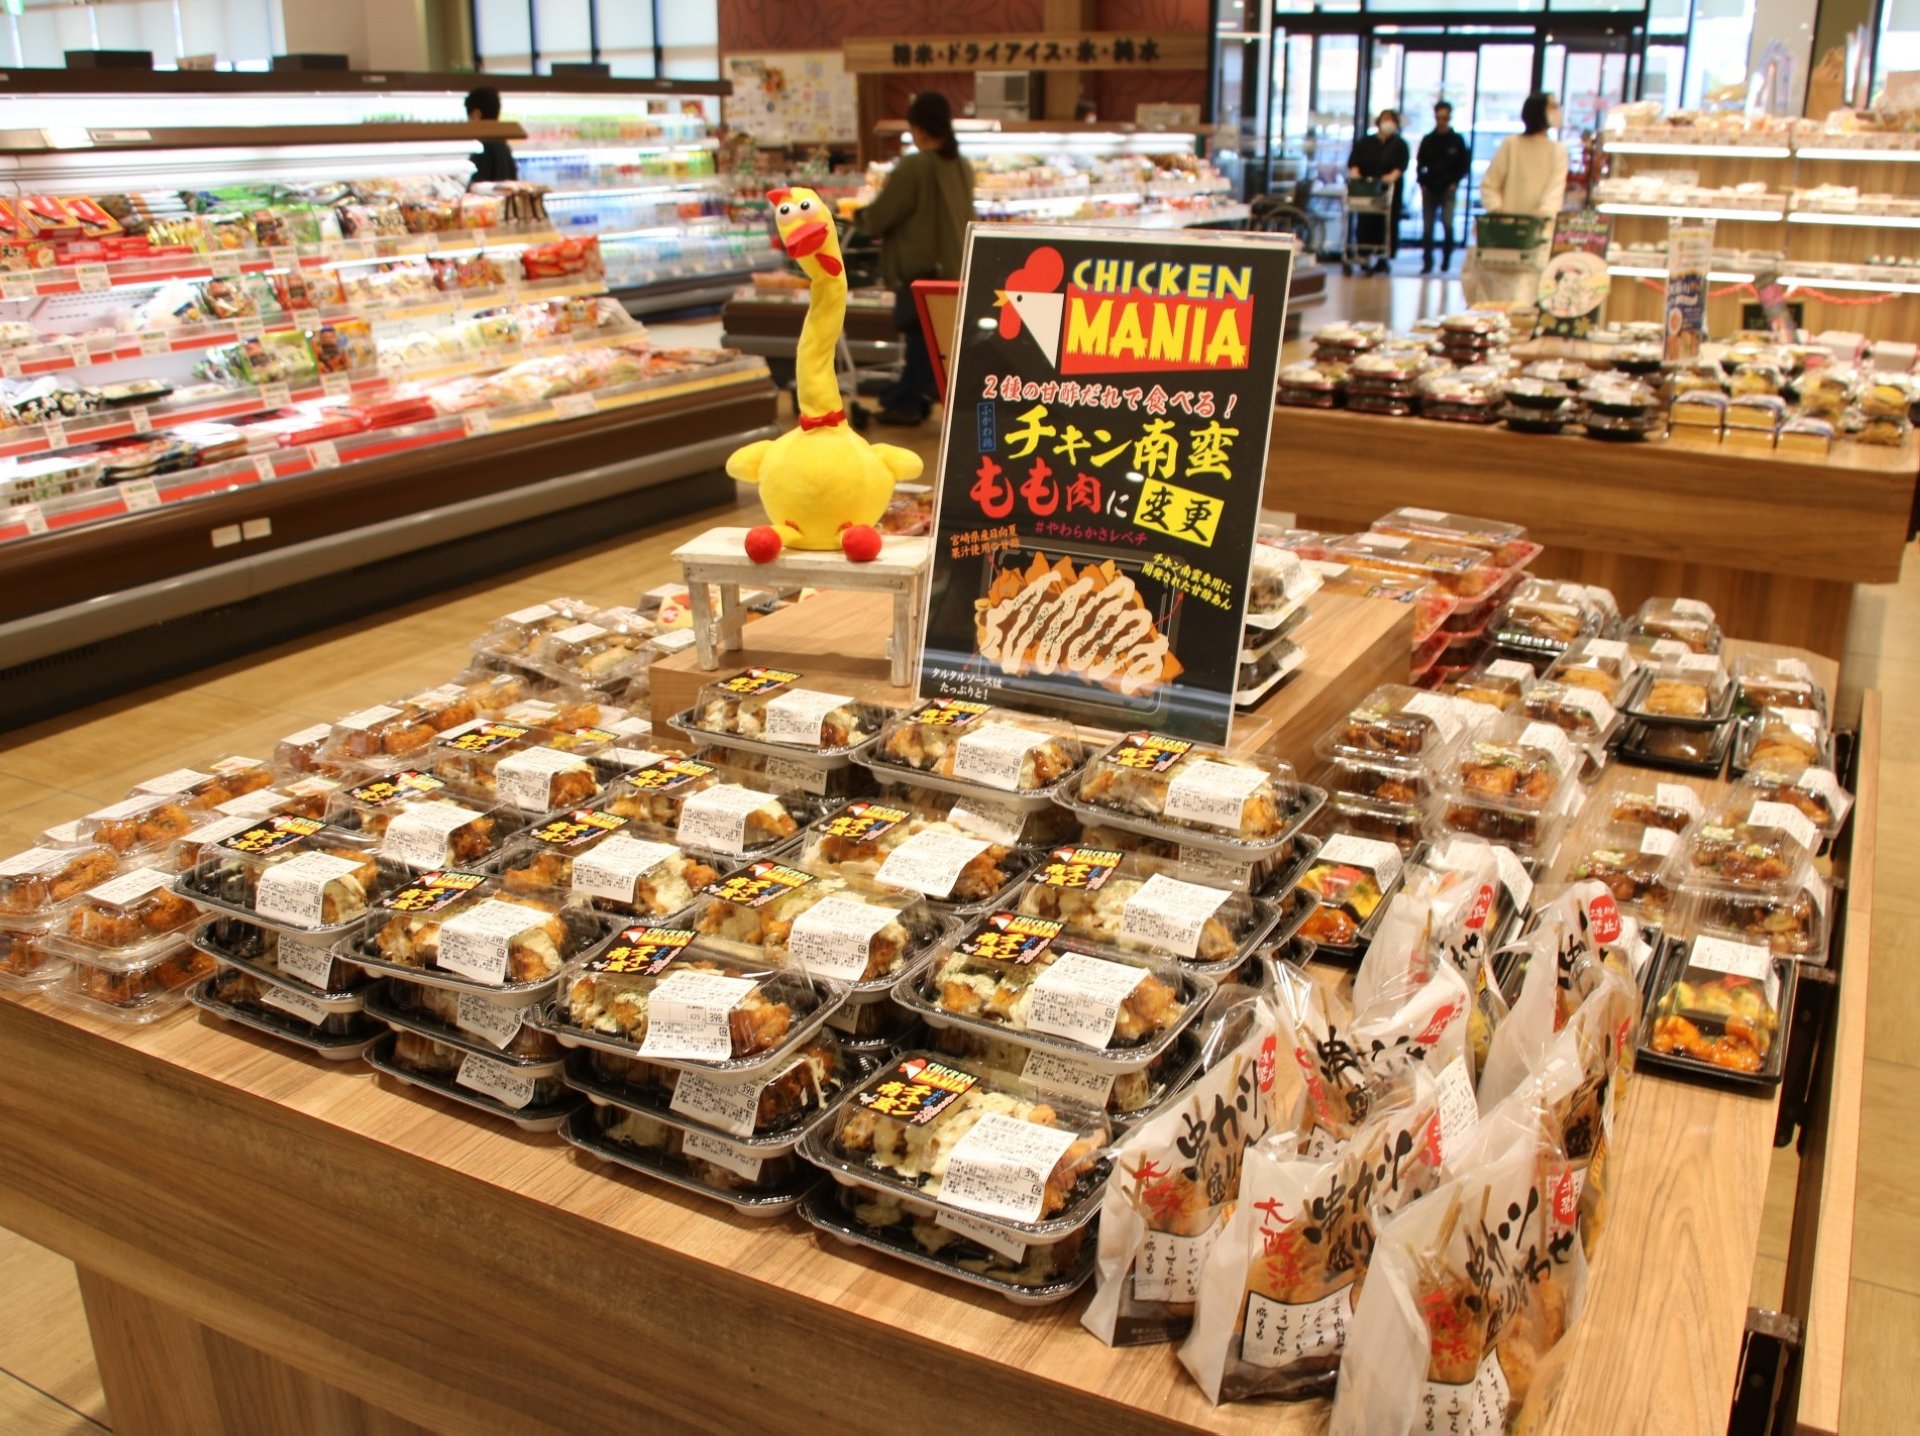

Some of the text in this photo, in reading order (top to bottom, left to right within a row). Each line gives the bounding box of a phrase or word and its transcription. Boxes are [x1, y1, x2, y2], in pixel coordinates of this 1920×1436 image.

[1071, 258, 1253, 301] CHICKEN
[1066, 298, 1247, 368] MANIA
[1004, 403, 1240, 482] チキン南蛮
[931, 667, 1003, 689] タルタルソースは
[1075, 848, 1122, 859] CHICKEN
[441, 872, 485, 883] CHICKEN
[773, 865, 814, 880] CHICKEN
[1014, 916, 1063, 930] CHICKEN
[646, 927, 695, 939] CHICKEN
[709, 1013, 723, 1023] 398
[926, 1062, 978, 1085] CHICKEN
[913, 1069, 967, 1094] MANIA
[741, 1083, 756, 1097] 398
[1025, 1167, 1041, 1182] 398
